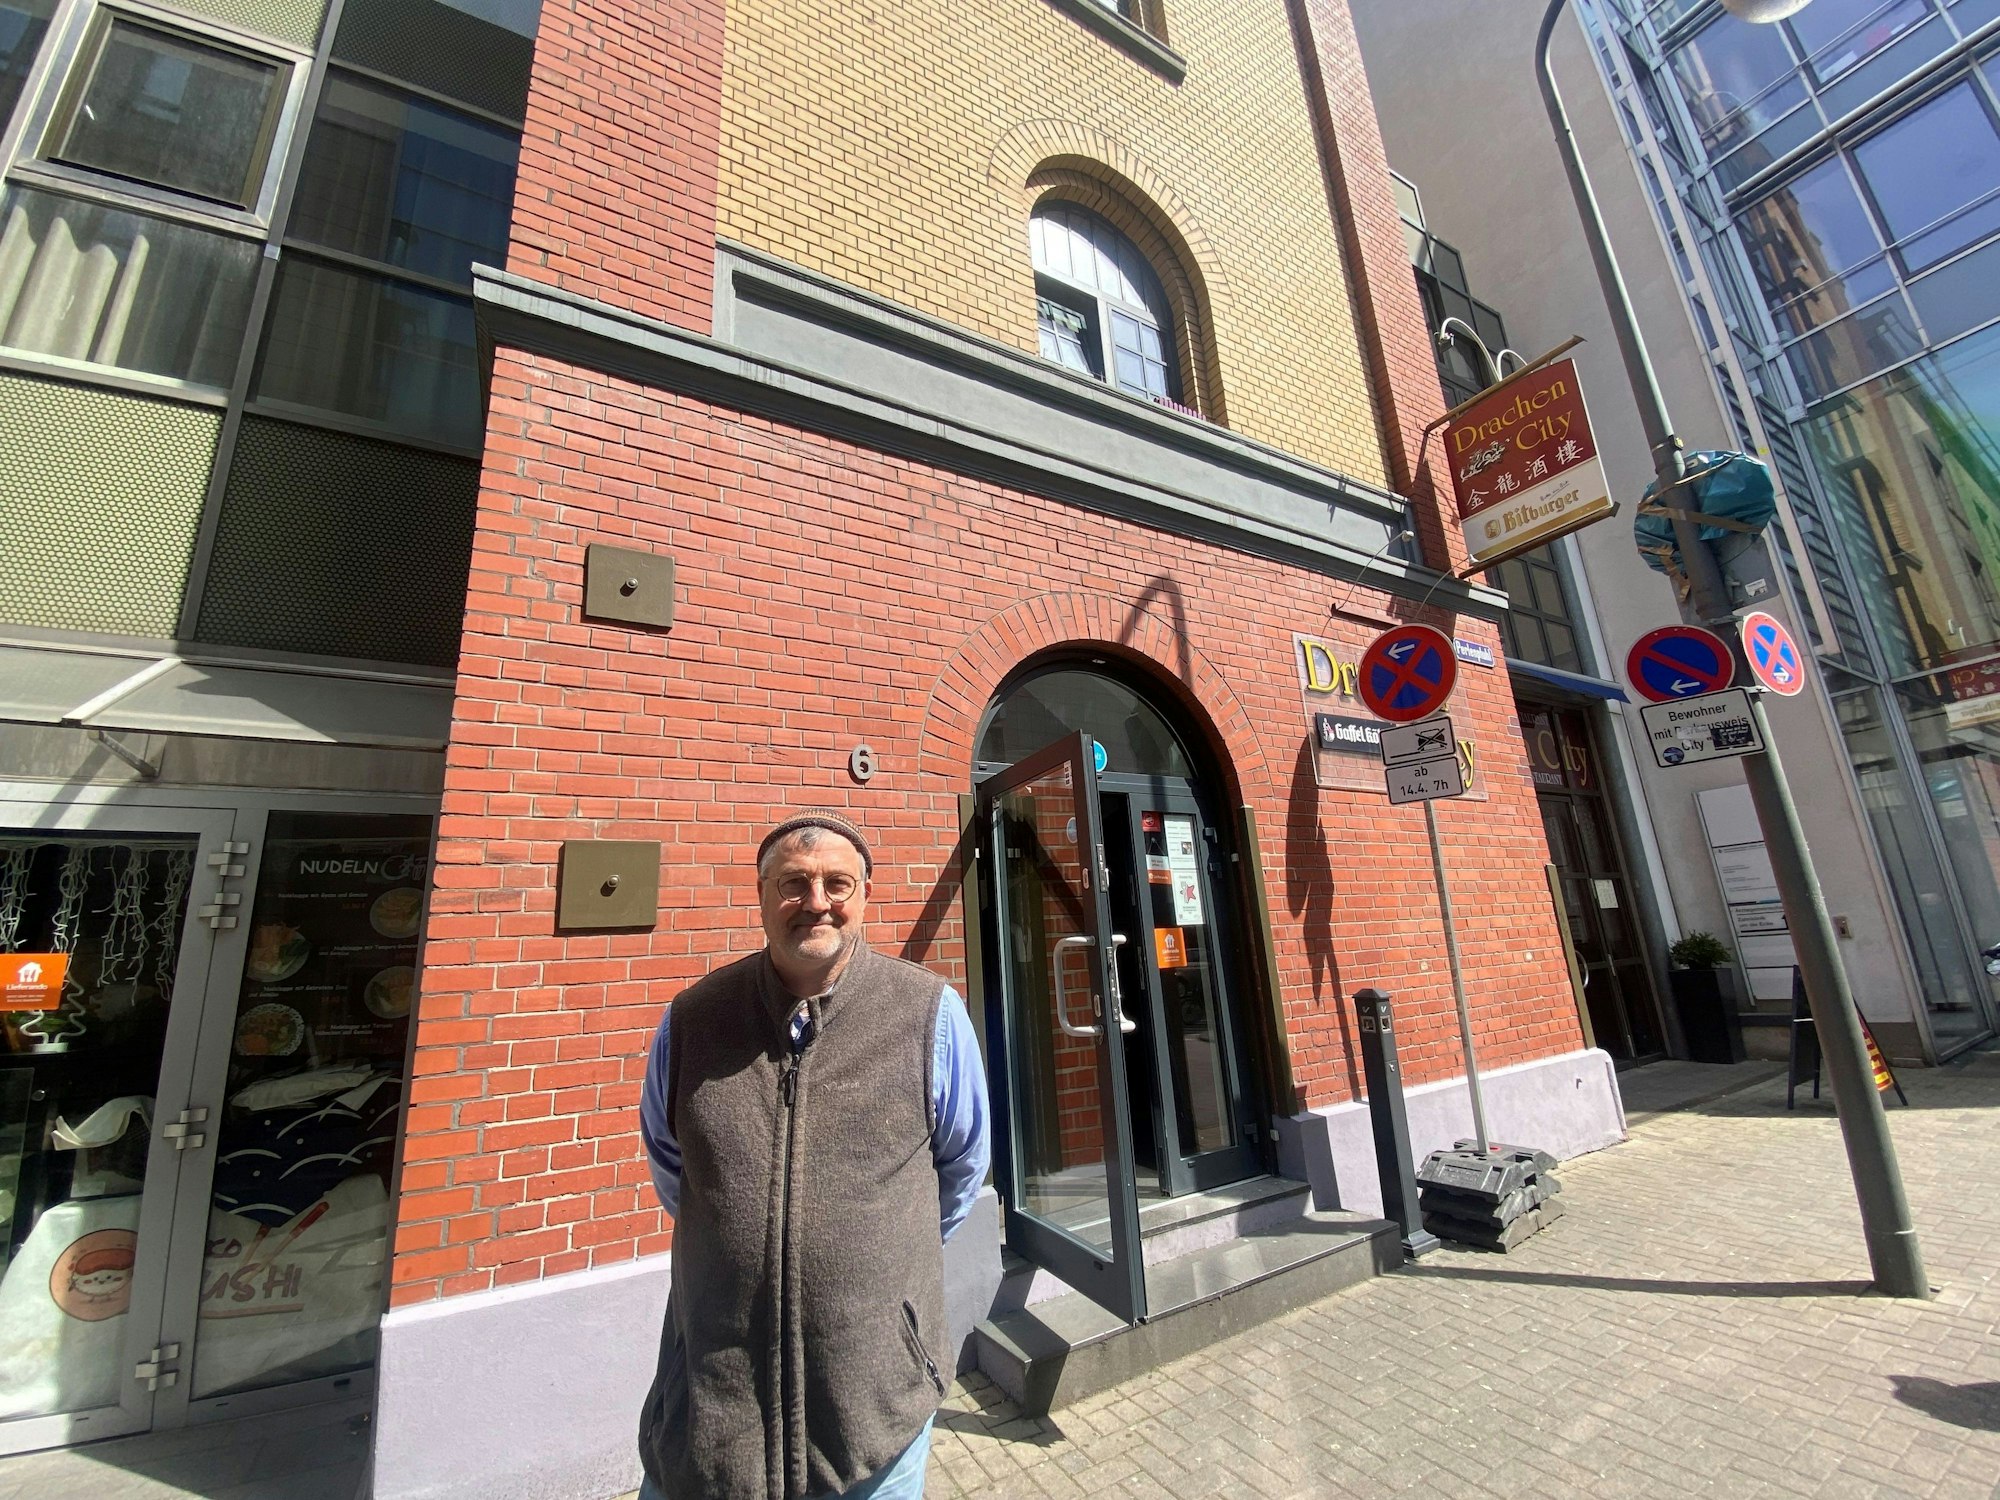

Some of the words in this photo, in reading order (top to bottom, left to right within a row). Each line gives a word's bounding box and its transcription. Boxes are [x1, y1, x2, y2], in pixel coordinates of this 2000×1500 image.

[1452, 379, 1568, 454] Drachen
[1515, 410, 1573, 450] City
[1466, 439, 1584, 510] 金龍酒樓
[1502, 489, 1579, 533] Bitburger
[1668, 704, 1727, 722] Bewohner
[1336, 722, 1366, 743] Gaffel
[1365, 726, 1380, 744] Kö
[1654, 728, 1673, 740] mit
[852, 743, 875, 780] 6
[1414, 766, 1428, 777] ab
[1400, 783, 1428, 796] 14.4.
[1433, 779, 1449, 791] 7h
[300, 859, 378, 875] NUDELN
[201, 1263, 303, 1302] USHI
